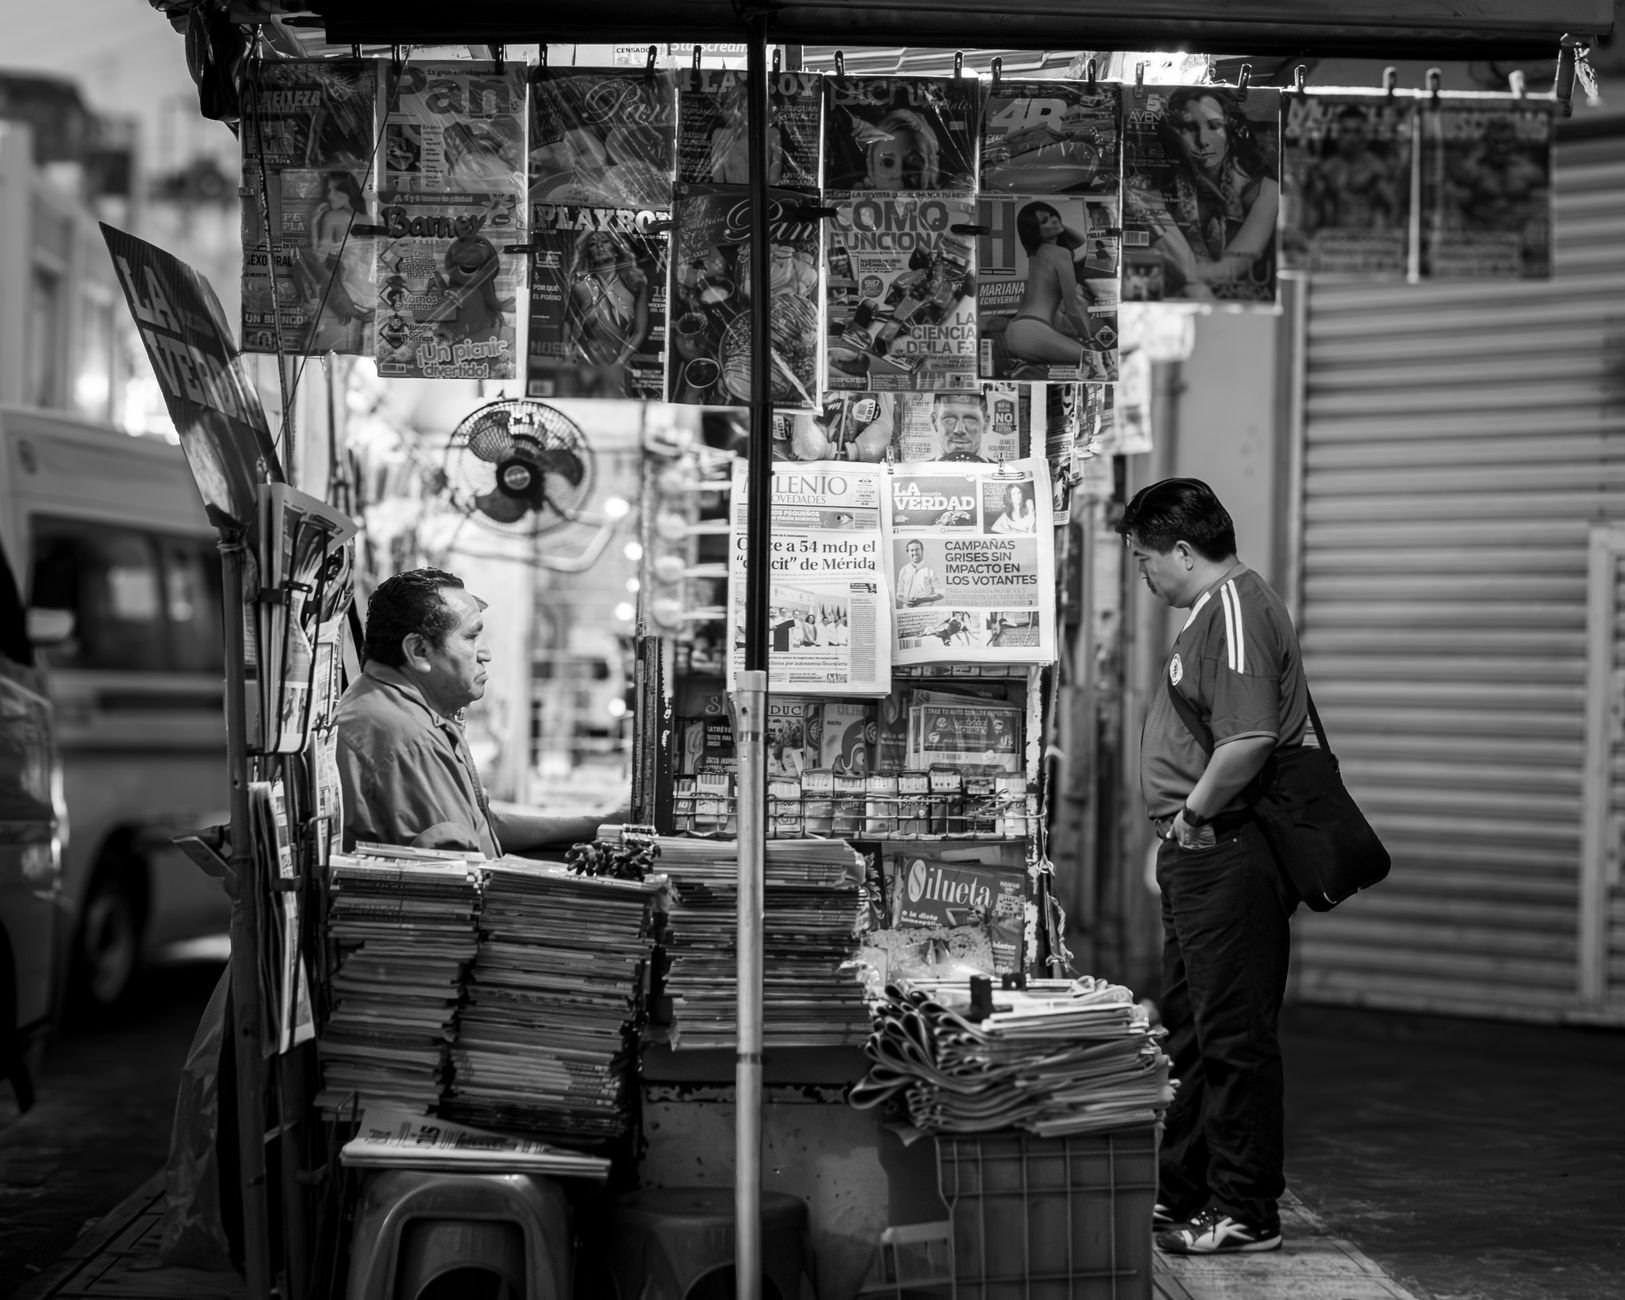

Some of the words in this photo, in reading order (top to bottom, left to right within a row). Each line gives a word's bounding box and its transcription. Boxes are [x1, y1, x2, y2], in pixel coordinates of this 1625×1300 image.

[681, 70, 818, 96] PLAOY
[381, 206, 487, 238] Barney
[979, 282, 1025, 297] MARIANA
[956, 312, 975, 326] LA
[911, 326, 975, 340] CIENCIA
[423, 362, 489, 379] divertido!
[996, 413, 1013, 423] NO
[742, 475, 848, 496] LENIO
[893, 482, 921, 497] LA
[768, 494, 827, 505] OVEDADES
[893, 496, 976, 511] VERDAD
[786, 542, 796, 553] a
[799, 540, 818, 553] 54
[822, 540, 859, 556] mdp
[862, 540, 876, 553] el
[944, 538, 1016, 551] CAMPAÑAS
[800, 557, 819, 571] de
[822, 556, 876, 571] Mérida
[945, 551, 990, 563] GRISES
[991, 551, 1012, 562] SIN
[945, 563, 1002, 574] IMPACTO
[1003, 562, 1020, 573] EN
[946, 575, 970, 586] LOS
[973, 574, 1038, 586] VOTANTES
[907, 858, 993, 909] Silueta
